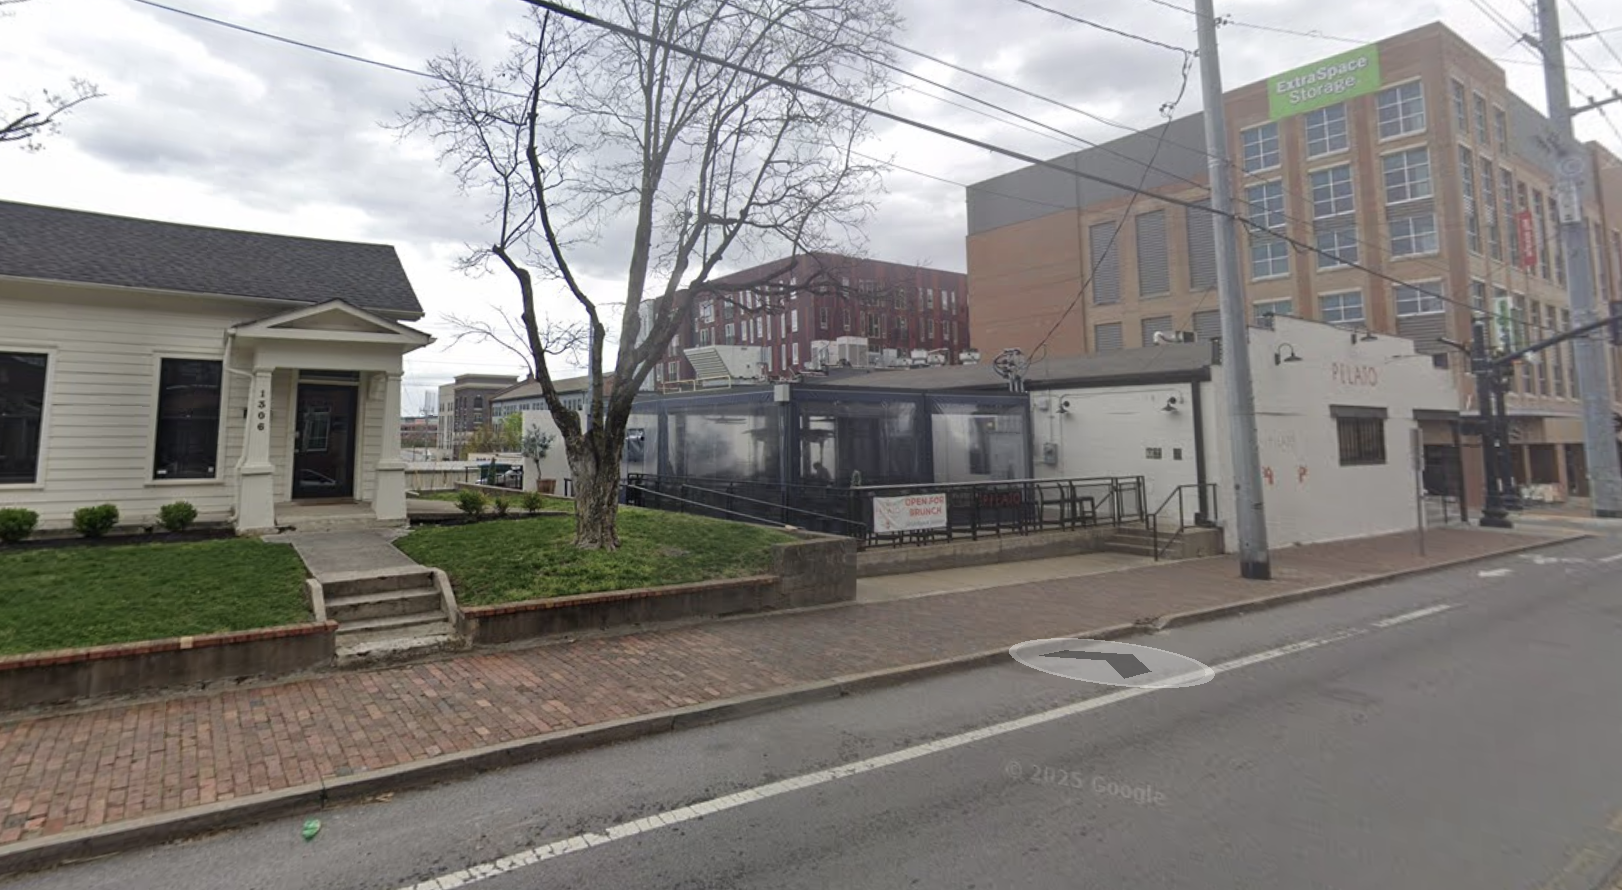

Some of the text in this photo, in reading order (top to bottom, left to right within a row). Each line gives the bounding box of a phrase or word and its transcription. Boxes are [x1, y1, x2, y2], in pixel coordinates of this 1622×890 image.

[1289, 77, 1356, 103] Storage
[257, 390, 267, 430] 1306
[905, 496, 944, 506] OPEN FOR
[909, 508, 942, 517] BRUNCH
